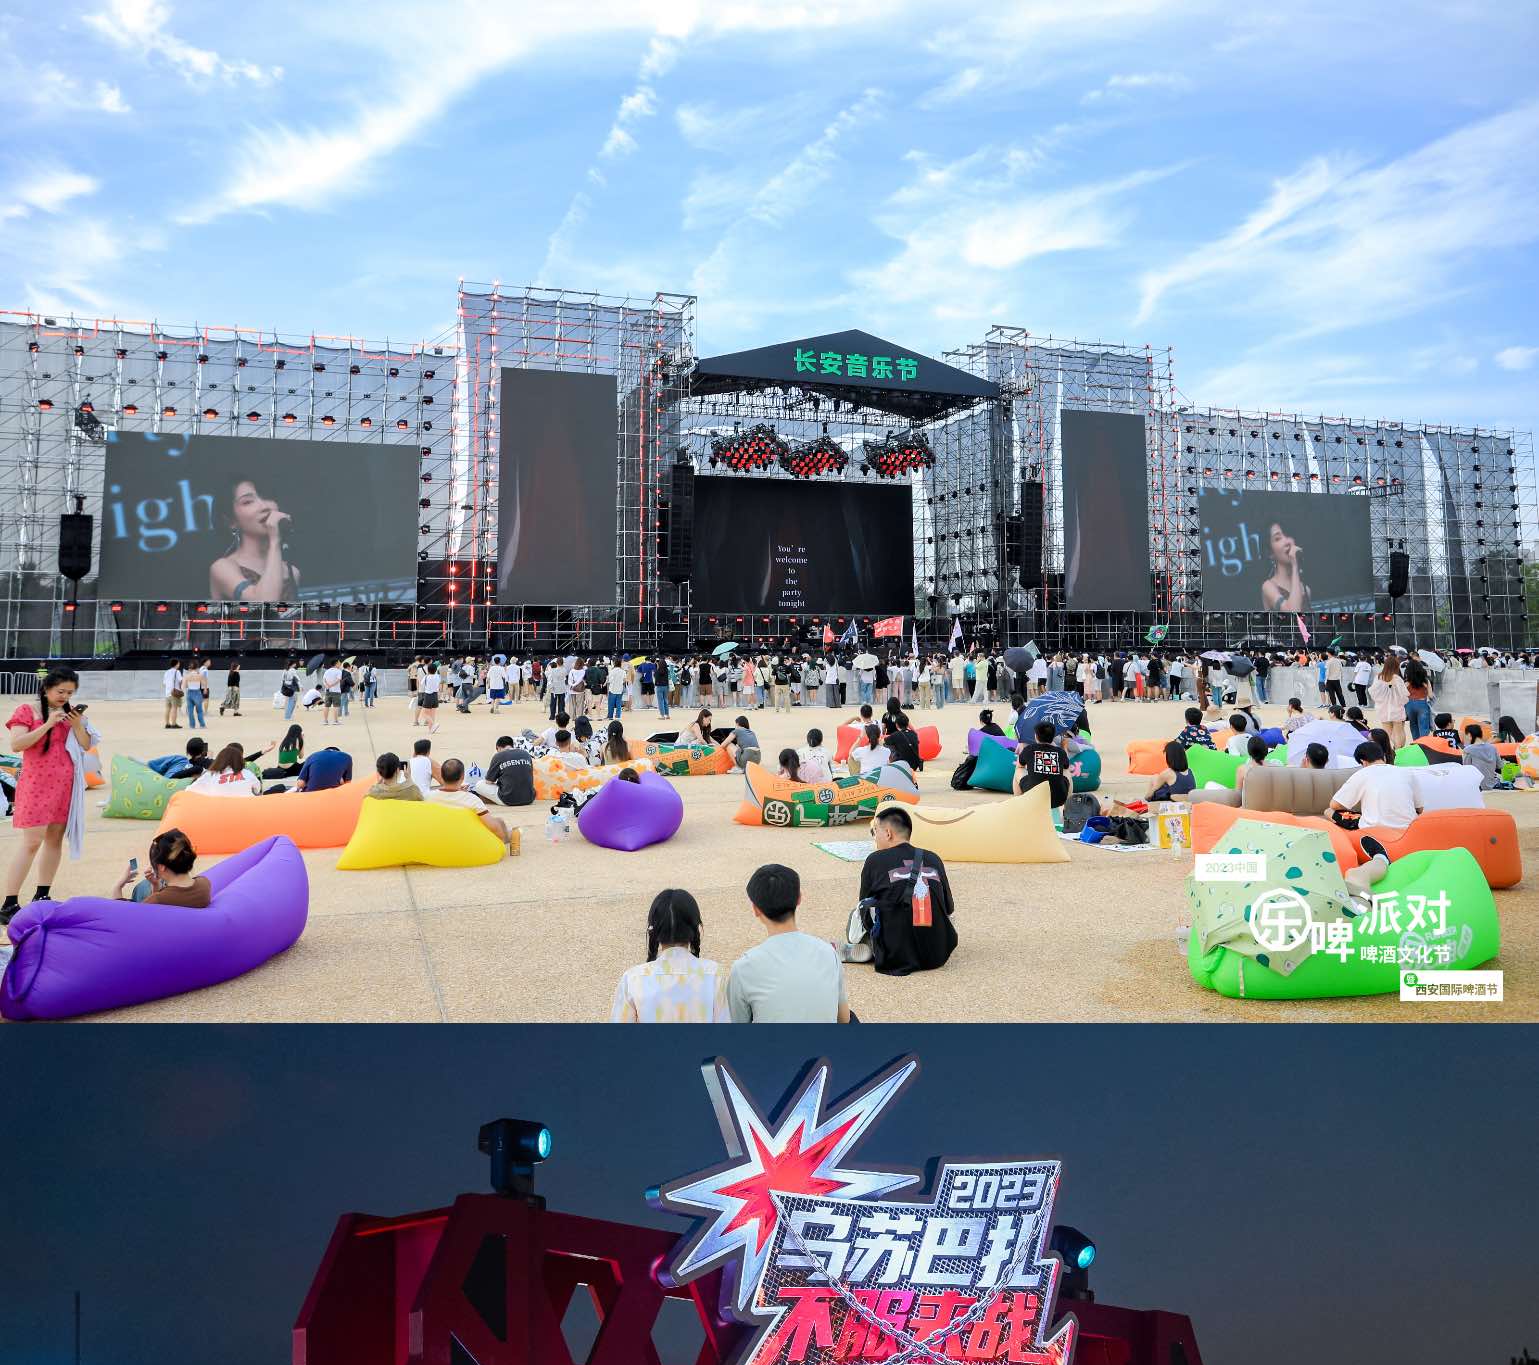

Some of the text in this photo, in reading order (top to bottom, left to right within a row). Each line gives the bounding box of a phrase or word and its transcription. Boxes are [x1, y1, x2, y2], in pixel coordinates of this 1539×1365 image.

[794, 348, 918, 381] 长安音乐节
[775, 556, 808, 564] welcome
[788, 567, 796, 575] to
[782, 589, 801, 598] party
[778, 600, 805, 608] tonight
[949, 1174, 1046, 1210] 2023
[776, 1207, 1043, 1289] 乌苏巴扎
